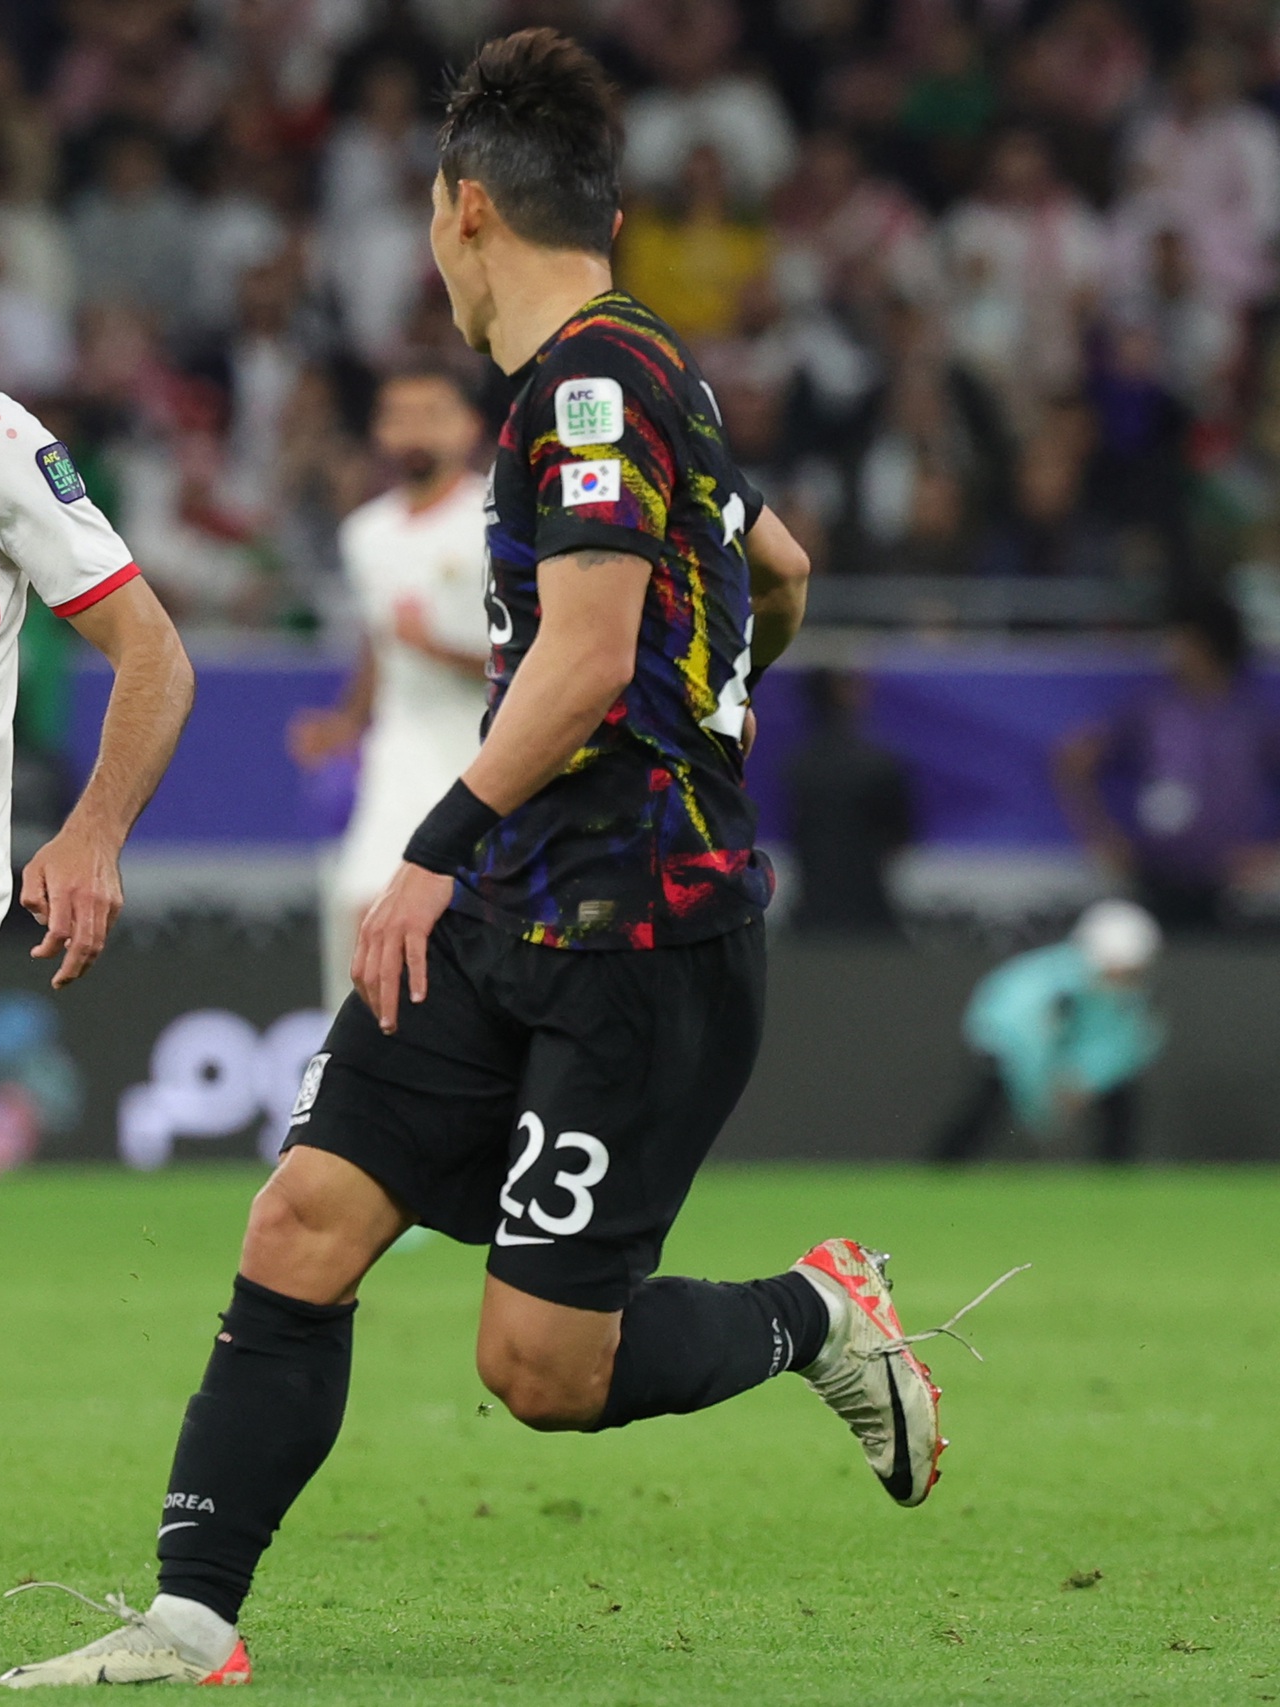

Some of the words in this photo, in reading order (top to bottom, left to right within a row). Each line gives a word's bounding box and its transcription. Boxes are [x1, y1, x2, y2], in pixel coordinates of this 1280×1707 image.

[567, 390, 594, 401] AFC
[567, 401, 613, 419] LIVE
[43, 450, 60, 466] AFC
[47, 459, 74, 481] LIVE
[499, 1109, 610, 1236] 23
